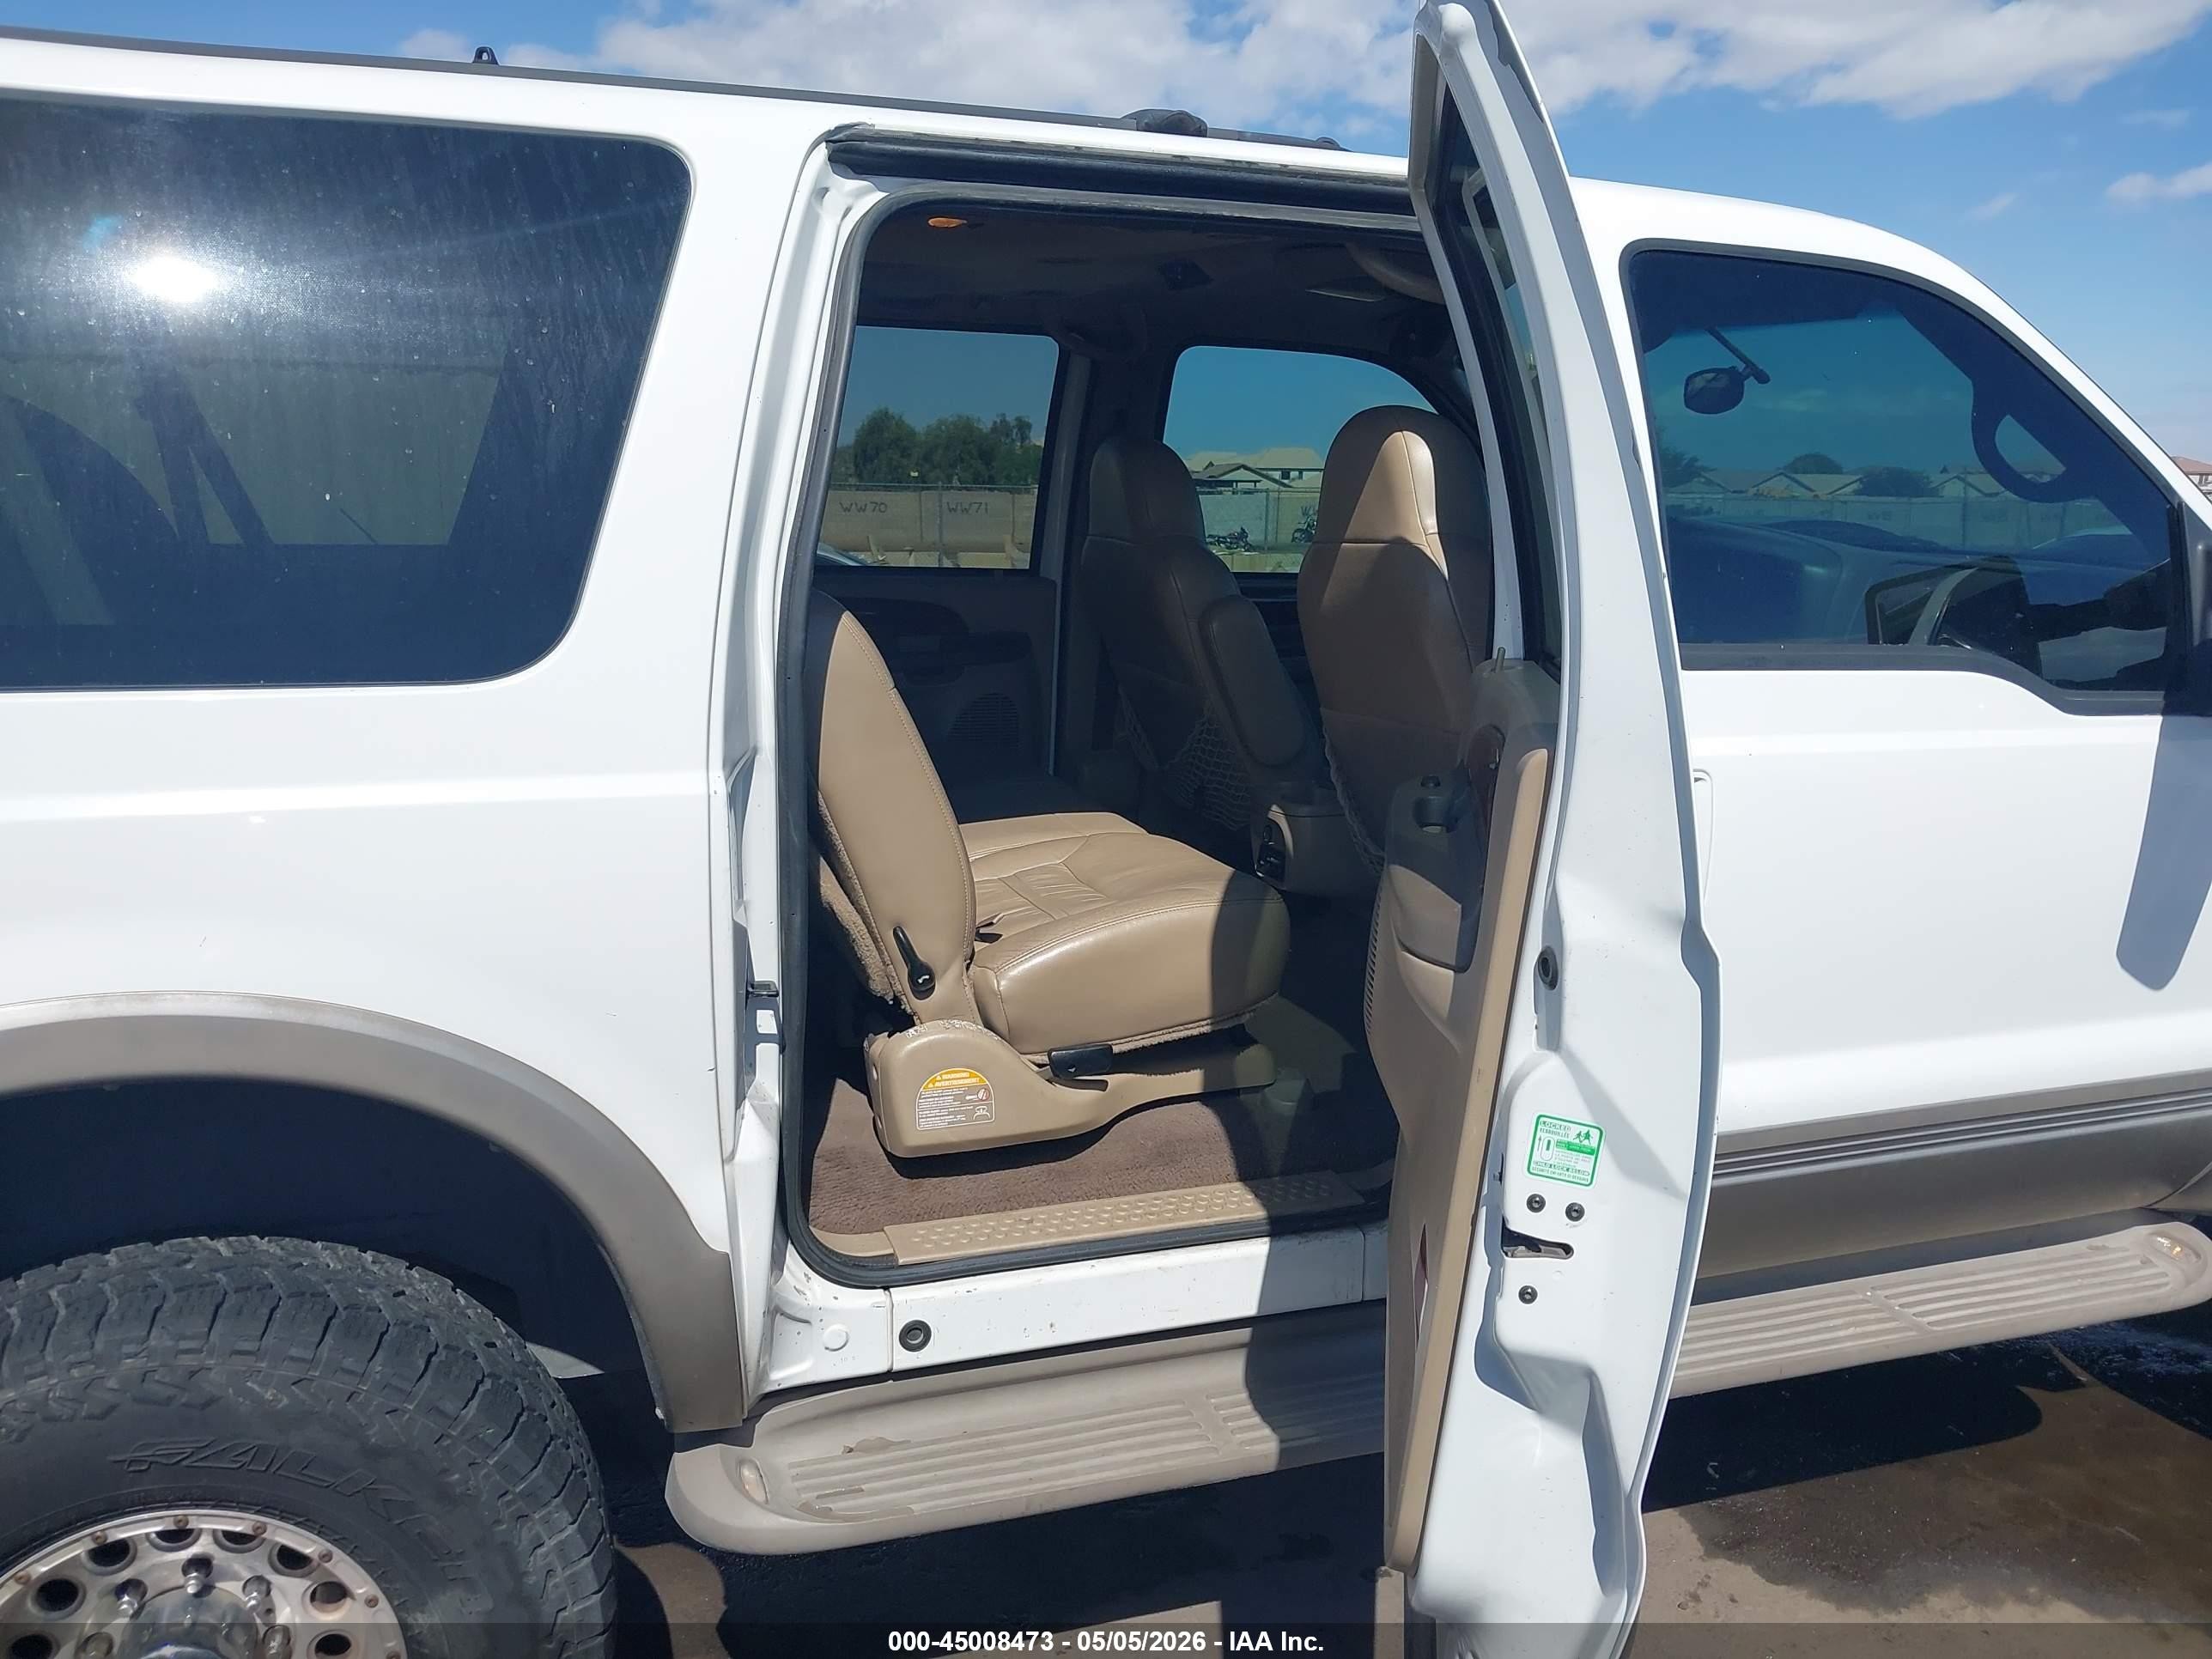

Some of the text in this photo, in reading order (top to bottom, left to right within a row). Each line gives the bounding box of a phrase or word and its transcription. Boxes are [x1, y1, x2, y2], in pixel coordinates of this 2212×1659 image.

[839, 501, 888, 514] WW70
[946, 501, 988, 514] WW71
[107, 1436, 493, 1611] FALK
